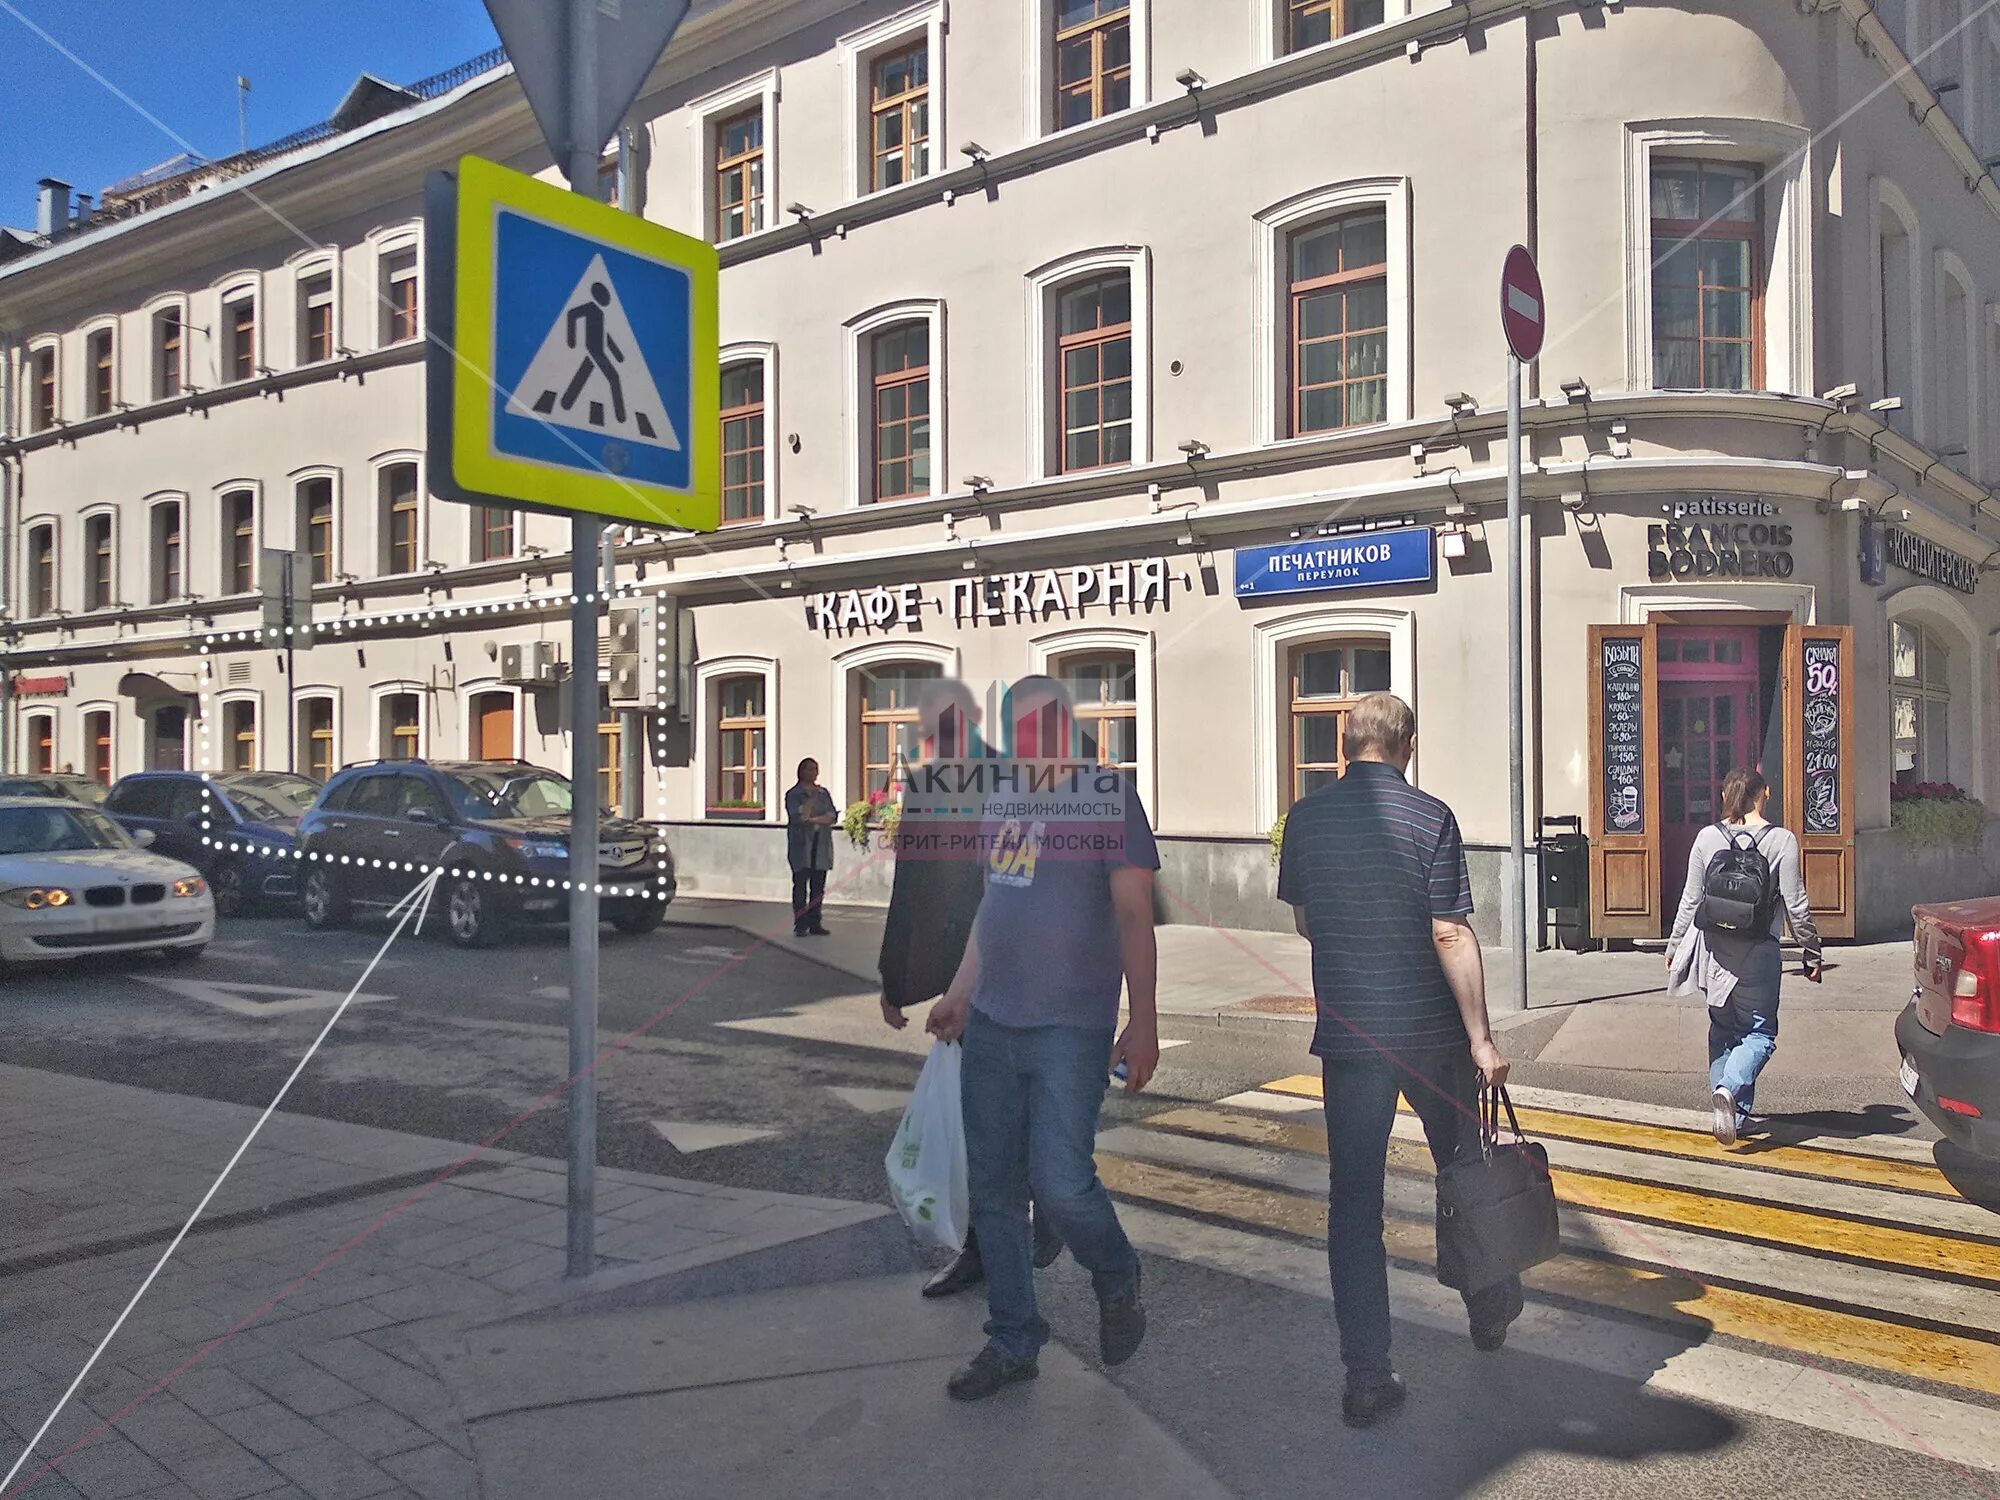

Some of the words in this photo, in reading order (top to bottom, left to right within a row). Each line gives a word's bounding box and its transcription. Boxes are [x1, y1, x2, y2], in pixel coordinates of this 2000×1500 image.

[1674, 496, 1773, 519] patisserie
[1268, 544, 1391, 573] ПЕЧАТНИКОВ
[1894, 528, 1976, 594] КОНДИТЕРСКАЯ
[1297, 567, 1360, 582] ПЕРЕУЛОК
[817, 582, 919, 630] КАФЕ
[949, 557, 1165, 619] ПЕКАРНЯ
[1608, 722, 1638, 733] ЭКЛЕРЫ
